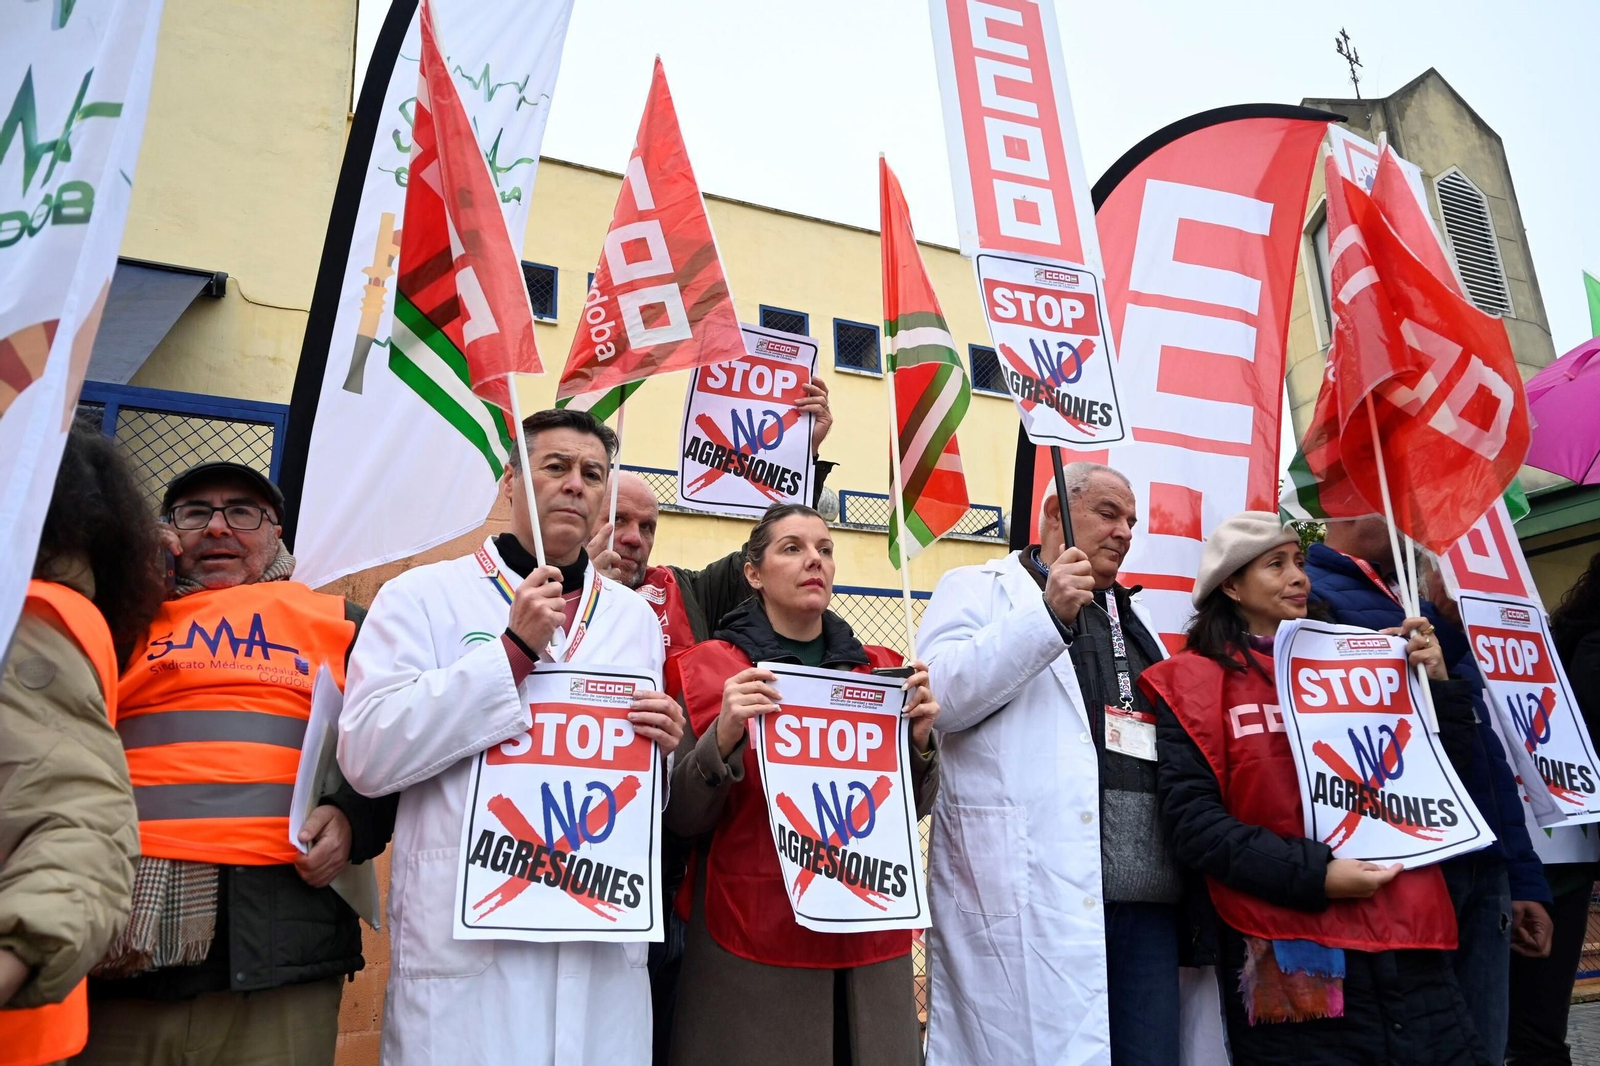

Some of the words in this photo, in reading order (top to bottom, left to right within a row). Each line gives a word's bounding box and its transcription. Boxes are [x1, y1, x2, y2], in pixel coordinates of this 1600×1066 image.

[966, 0, 1061, 245] CCOO
[1046, 271, 1071, 281] CCOO
[993, 287, 1085, 328] STOP
[768, 342, 792, 353] CCOO
[1029, 338, 1082, 388] NO
[706, 360, 798, 399] STOP
[1003, 364, 1113, 427] AGRESIONES
[731, 408, 784, 457] NO
[684, 436, 803, 496] AGRESIONES
[147, 613, 299, 661] SMA
[1349, 640, 1381, 648] CCOO
[1475, 634, 1539, 676] STOP
[149, 659, 206, 676] Sindicato
[210, 660, 253, 671] Médico
[256, 664, 300, 677] Andaluz
[588, 682, 624, 693] CCOO
[1298, 667, 1400, 707] STOP
[846, 689, 876, 700] CCOO
[775, 714, 883, 762] STOP
[1506, 692, 1551, 751] NO
[1348, 724, 1404, 788] NO
[541, 780, 617, 856] NO
[812, 781, 876, 849] NO
[1313, 771, 1459, 828] AGRESIONES
[468, 829, 644, 909] AGRESIONES
[778, 823, 908, 898] AGRESIONES
